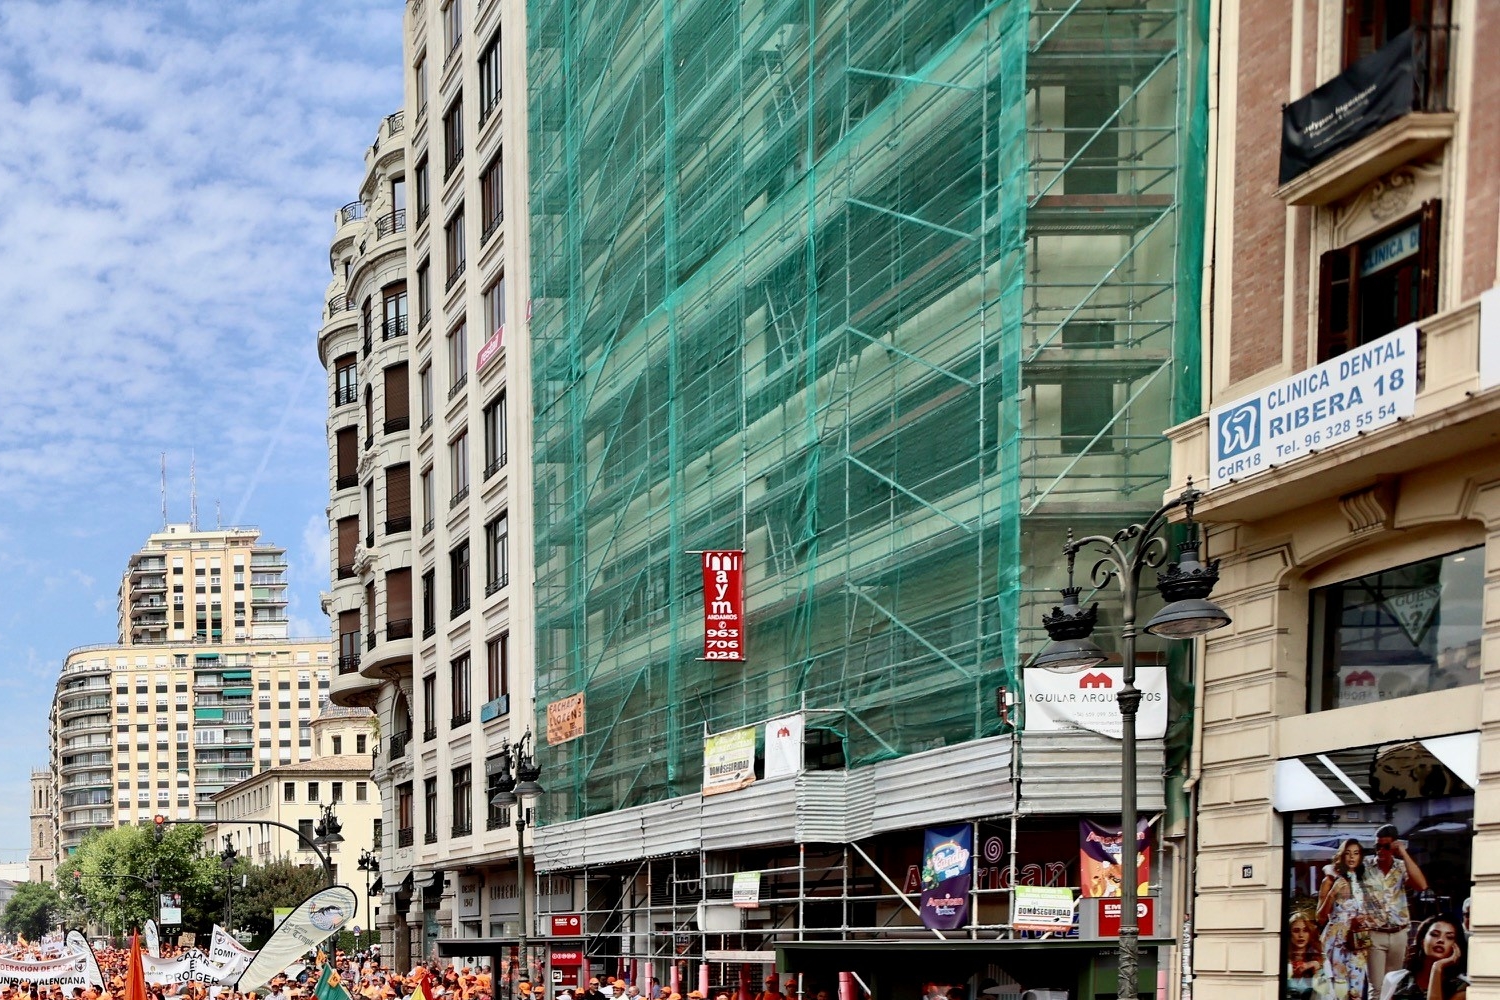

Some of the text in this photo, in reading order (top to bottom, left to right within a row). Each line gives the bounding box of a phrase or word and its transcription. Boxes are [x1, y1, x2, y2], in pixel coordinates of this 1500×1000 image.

[1267, 338, 1405, 410] CLINICA DENTAL
[1269, 368, 1404, 439] RIBERA 18
[1276, 402, 1396, 458] Tel. 96 328 55 54
[1218, 453, 1261, 479] CdR18
[1395, 585, 1442, 607] GUESS
[707, 629, 739, 637] 963
[707, 640, 739, 648] 706
[706, 651, 740, 659] 028
[1028, 693, 1076, 703] AGUILAR
